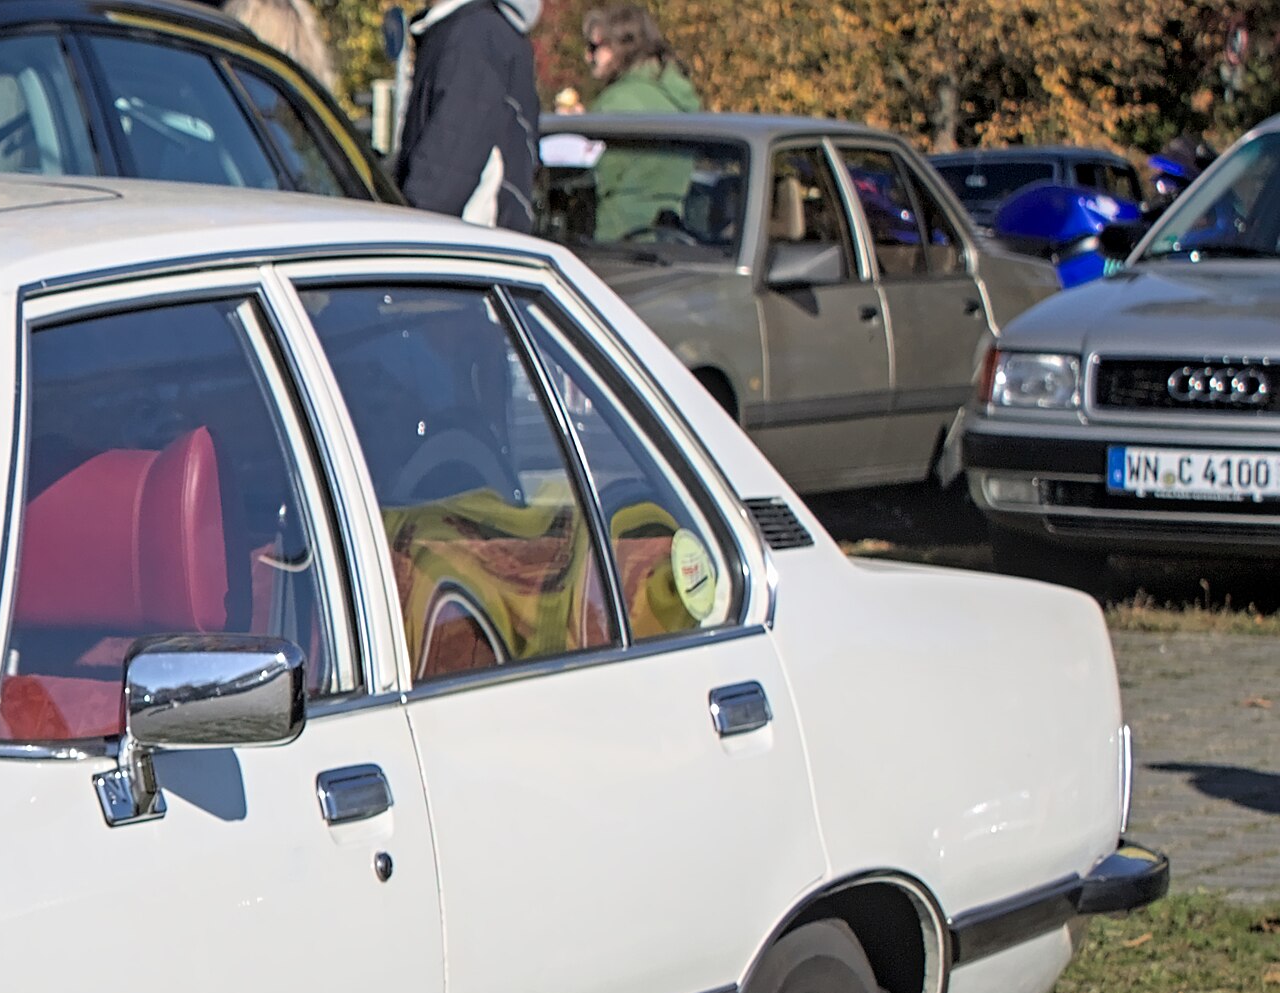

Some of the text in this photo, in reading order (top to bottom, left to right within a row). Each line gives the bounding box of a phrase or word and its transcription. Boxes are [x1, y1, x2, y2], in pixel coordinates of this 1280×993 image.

[1127, 455, 1269, 487] WN C 4100
